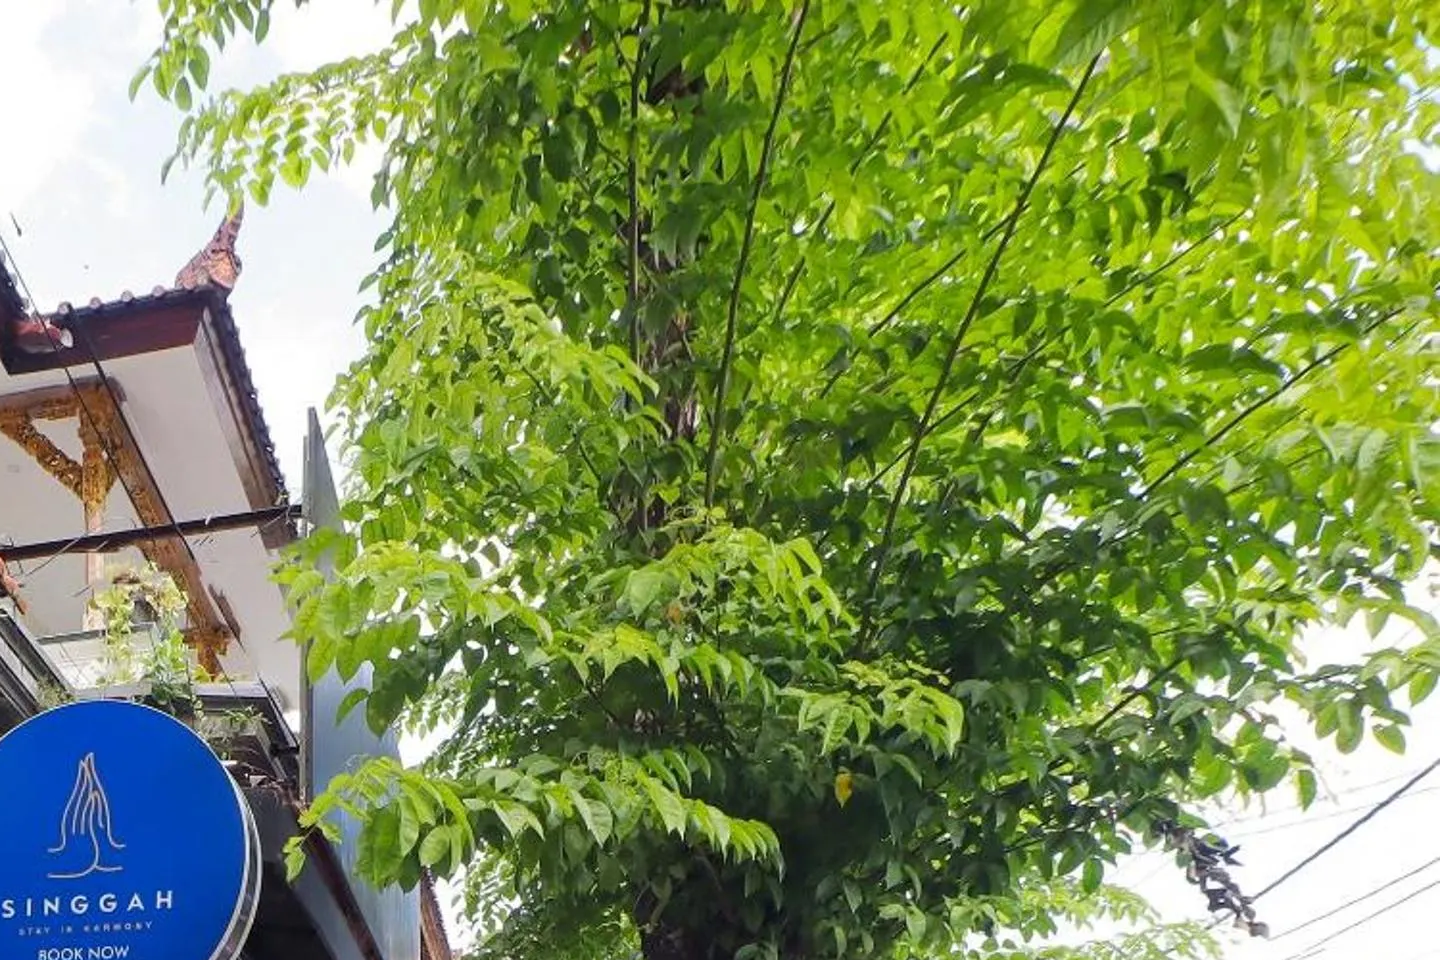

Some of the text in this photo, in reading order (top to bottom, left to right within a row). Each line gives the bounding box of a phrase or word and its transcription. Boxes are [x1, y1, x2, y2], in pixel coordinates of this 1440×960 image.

[1, 889, 173, 919] SINGGAH
[18, 926, 51, 937] STAY
[88, 945, 130, 960] NOW
